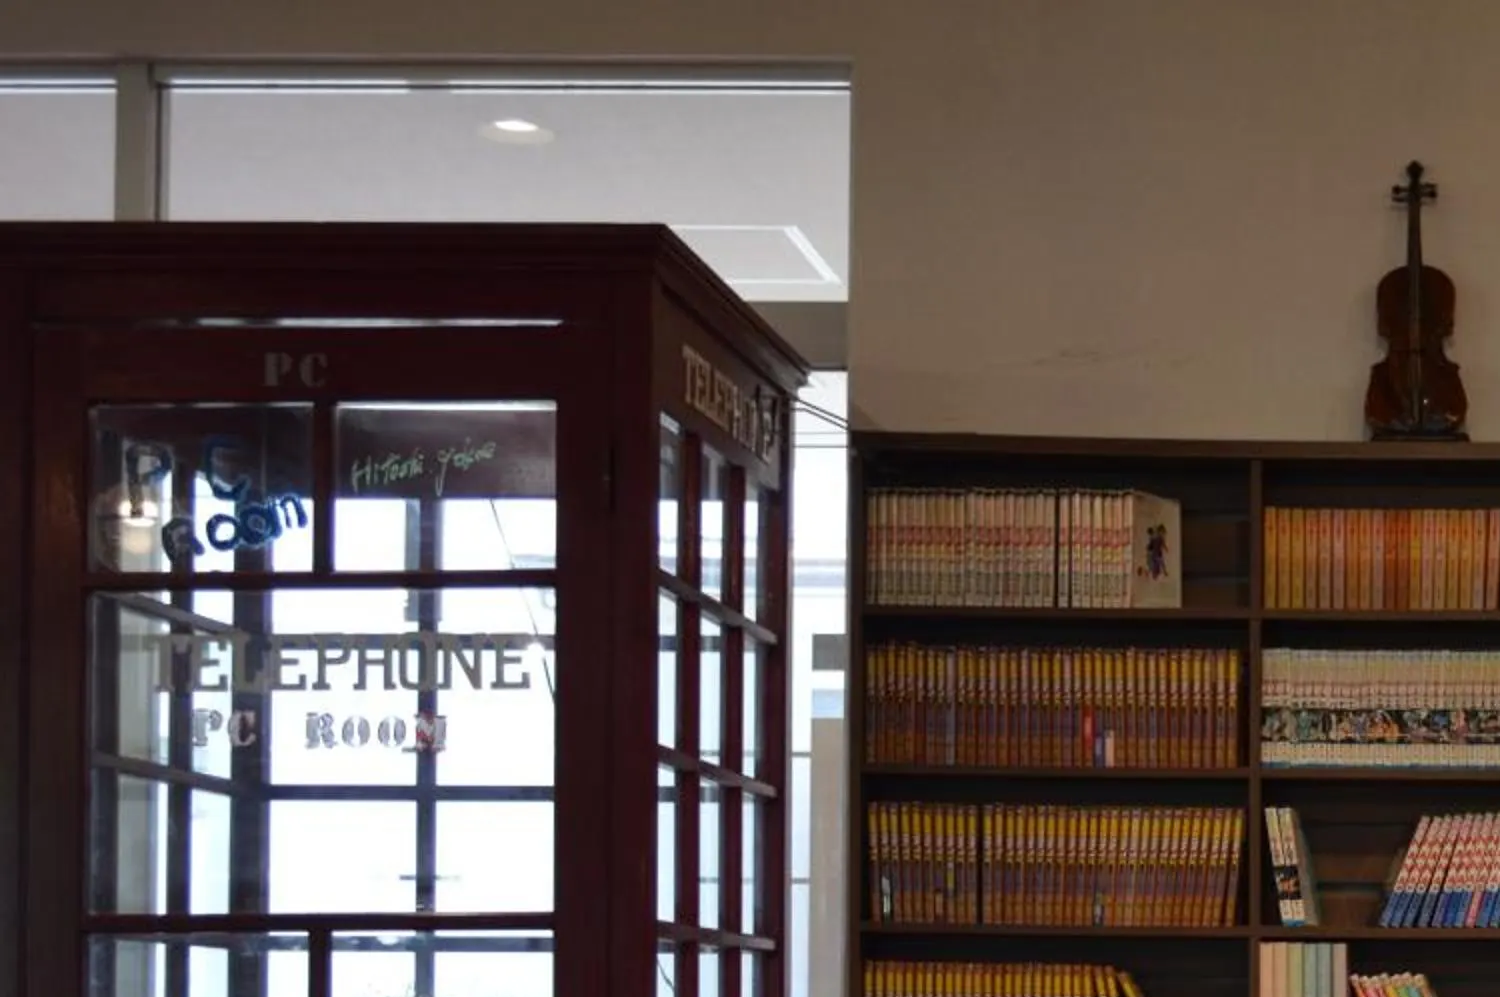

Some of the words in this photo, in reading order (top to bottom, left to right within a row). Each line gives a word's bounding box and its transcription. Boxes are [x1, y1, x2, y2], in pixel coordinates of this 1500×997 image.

[264, 352, 328, 388] PC
[151, 631, 531, 692] TELEPHONE
[191, 708, 257, 748] PC
[306, 712, 448, 753] ROOM
